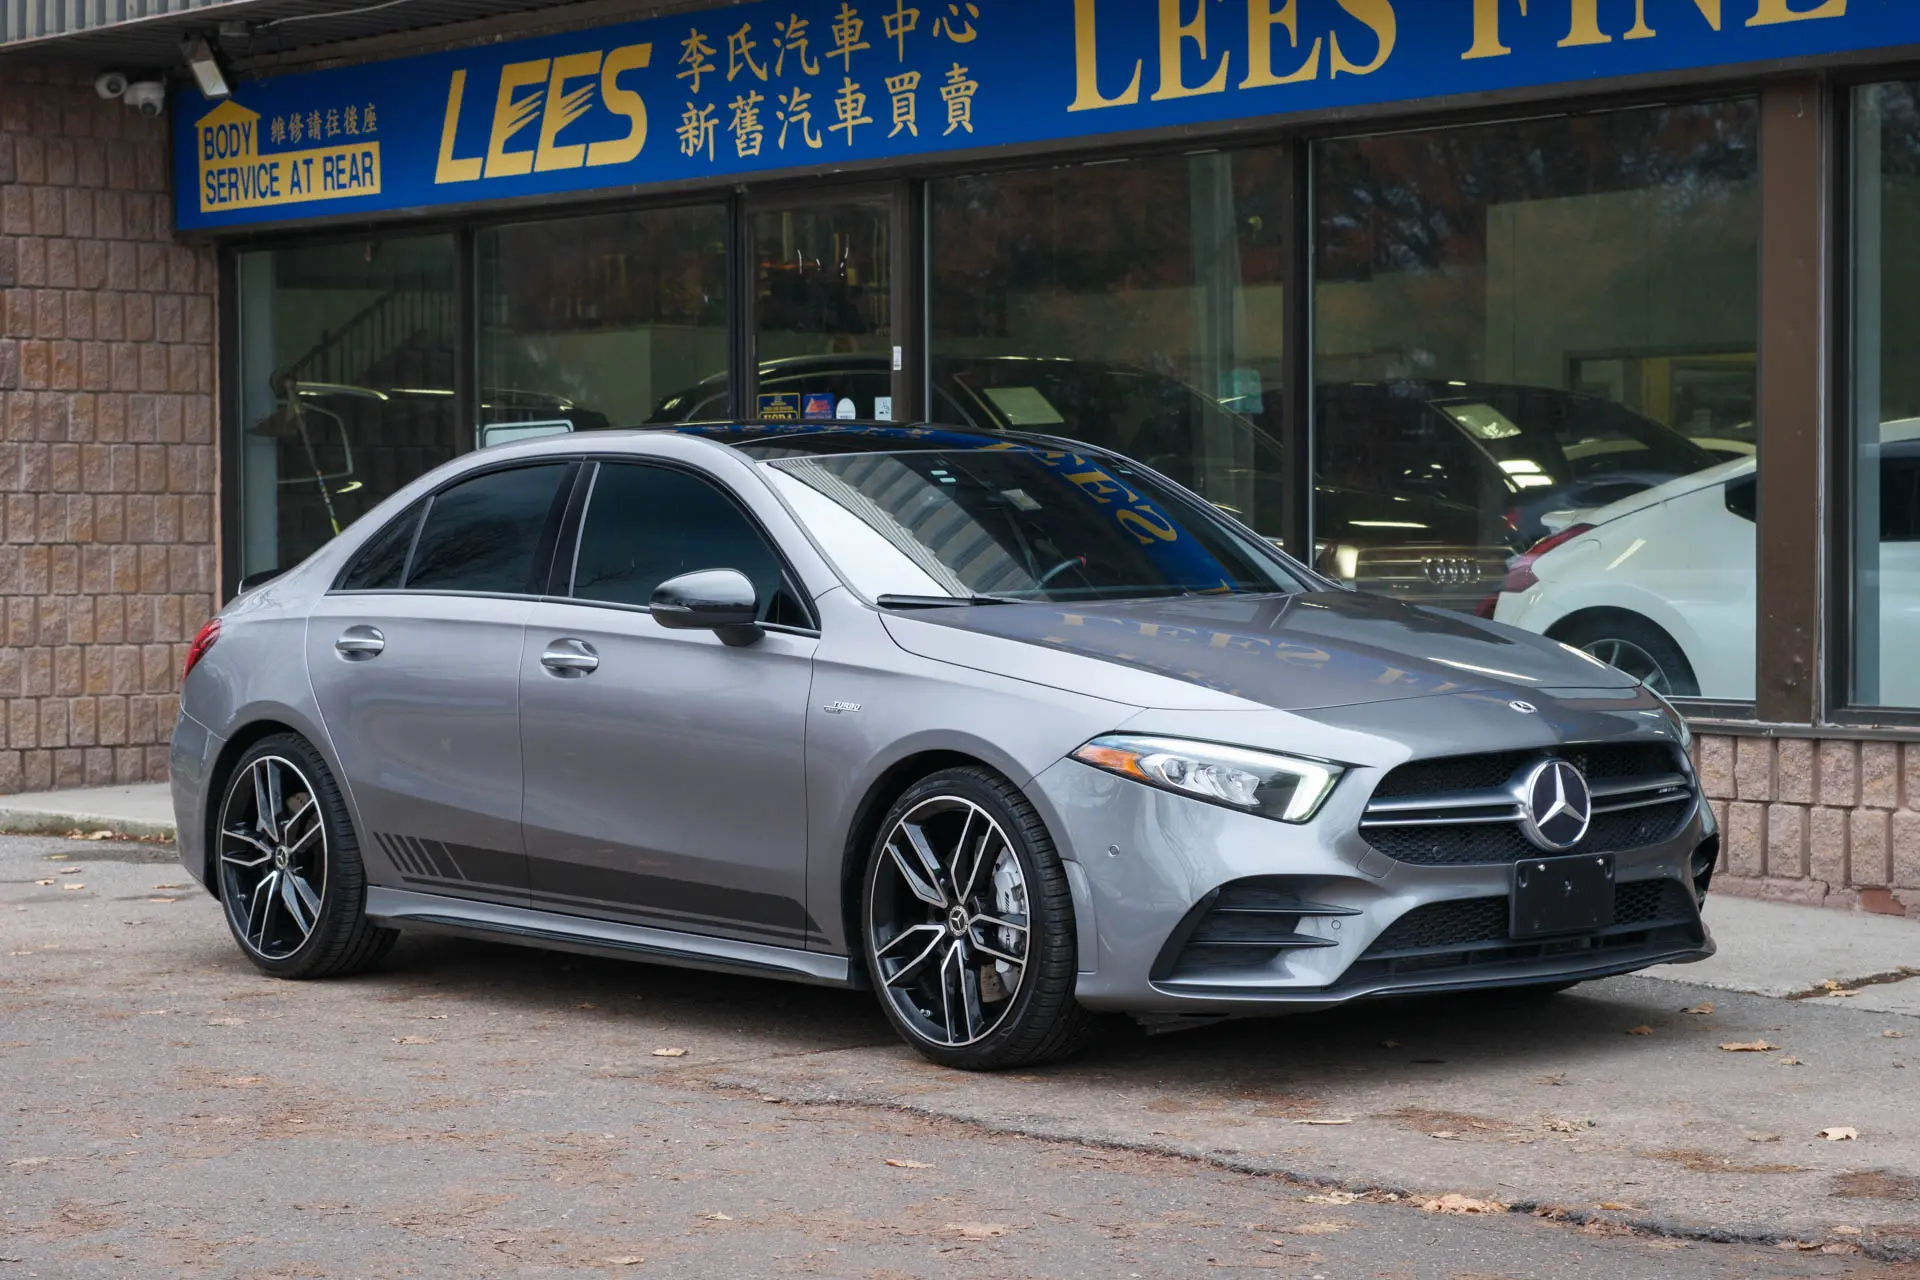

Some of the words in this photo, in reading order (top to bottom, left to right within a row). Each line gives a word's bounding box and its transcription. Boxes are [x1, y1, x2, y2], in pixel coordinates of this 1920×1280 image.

[675, 0, 980, 94] 李氏汽車中心
[203, 118, 252, 161] BODY
[434, 42, 653, 184] LEES
[675, 62, 980, 162] 新舊汽車買賣
[205, 161, 281, 205] SERVICE
[290, 157, 314, 195] AT
[322, 150, 375, 191] REAR
